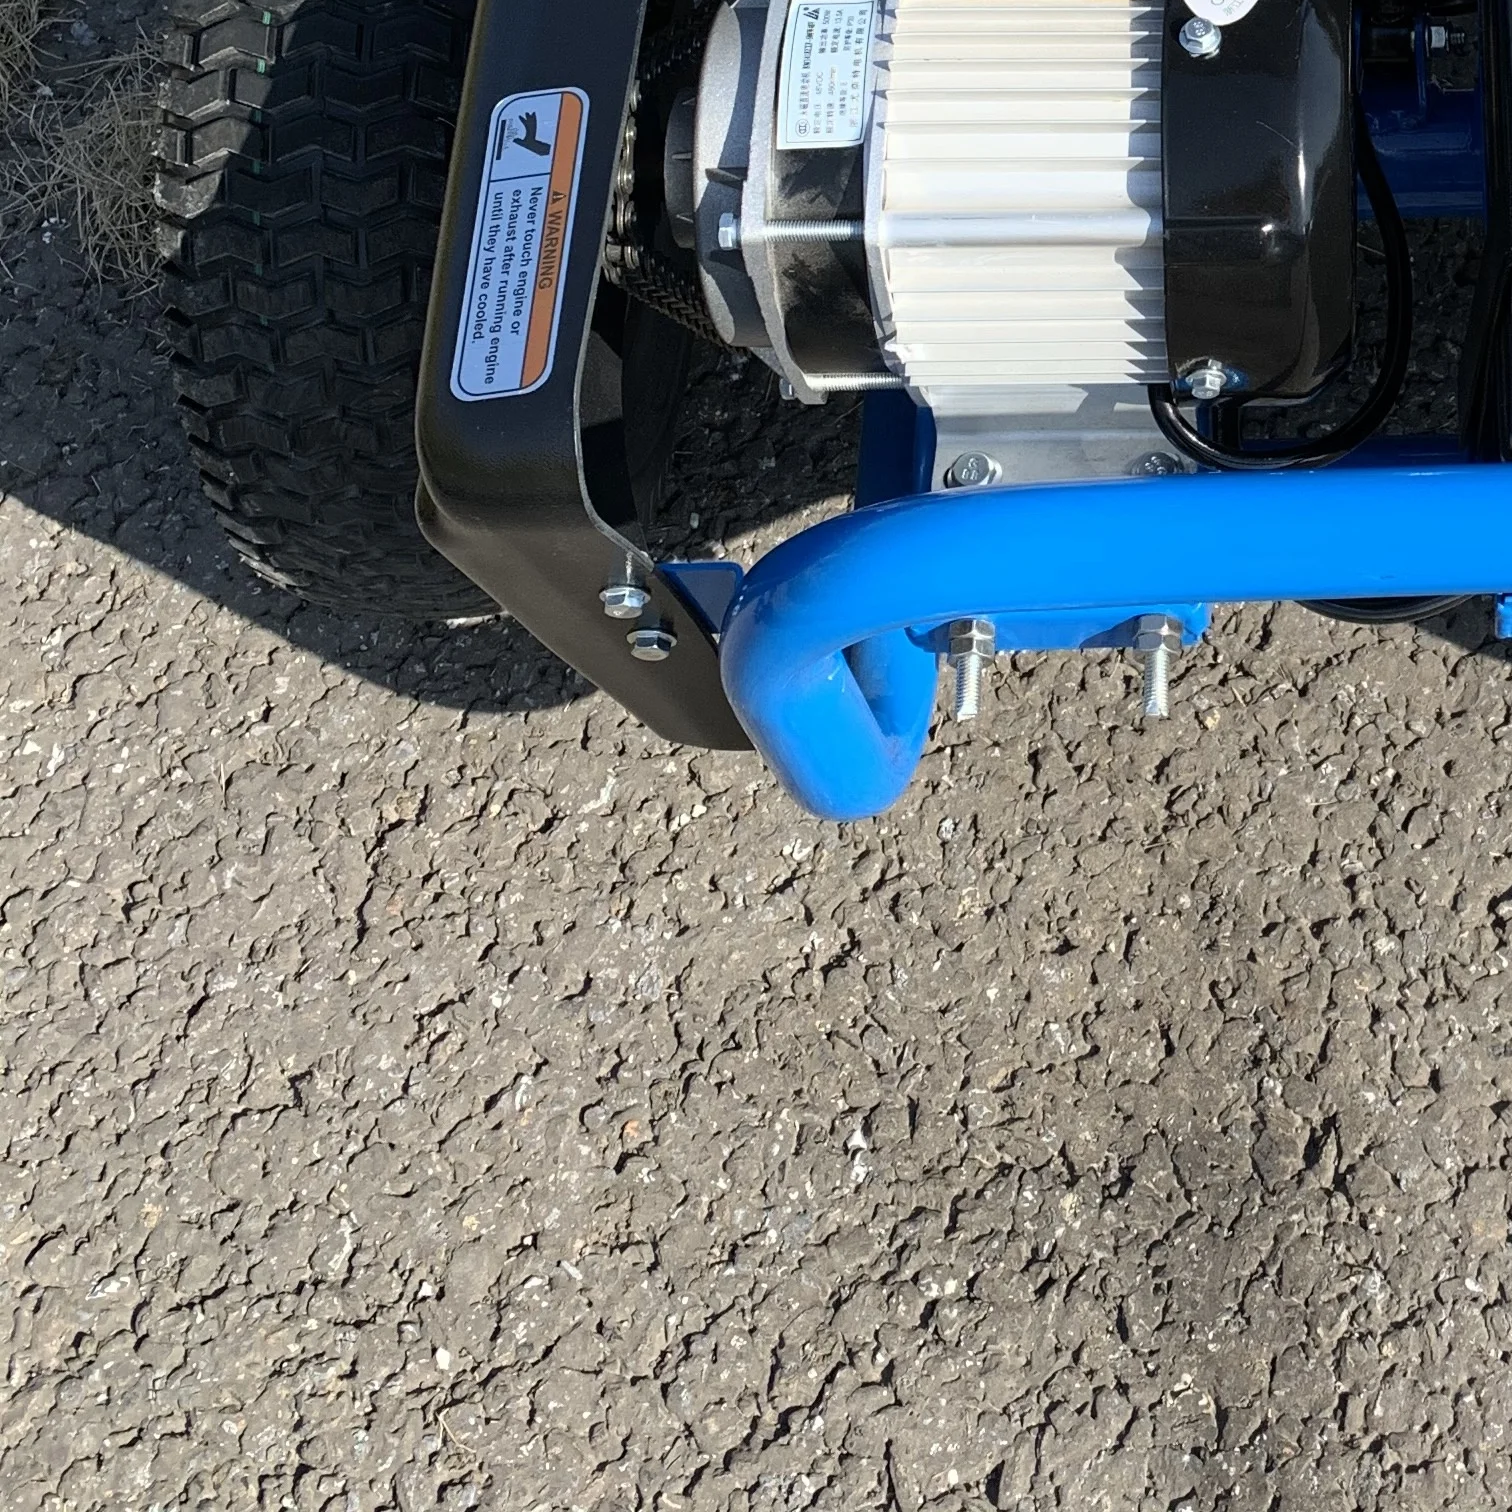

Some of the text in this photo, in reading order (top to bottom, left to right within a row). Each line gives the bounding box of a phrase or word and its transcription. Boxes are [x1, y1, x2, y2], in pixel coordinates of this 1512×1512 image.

[472, 192, 504, 344] until they have cooled.
[484, 189, 522, 385] exhaust after running engine
[510, 186, 543, 335] Never touch engine or
[538, 210, 563, 289] WARNING
